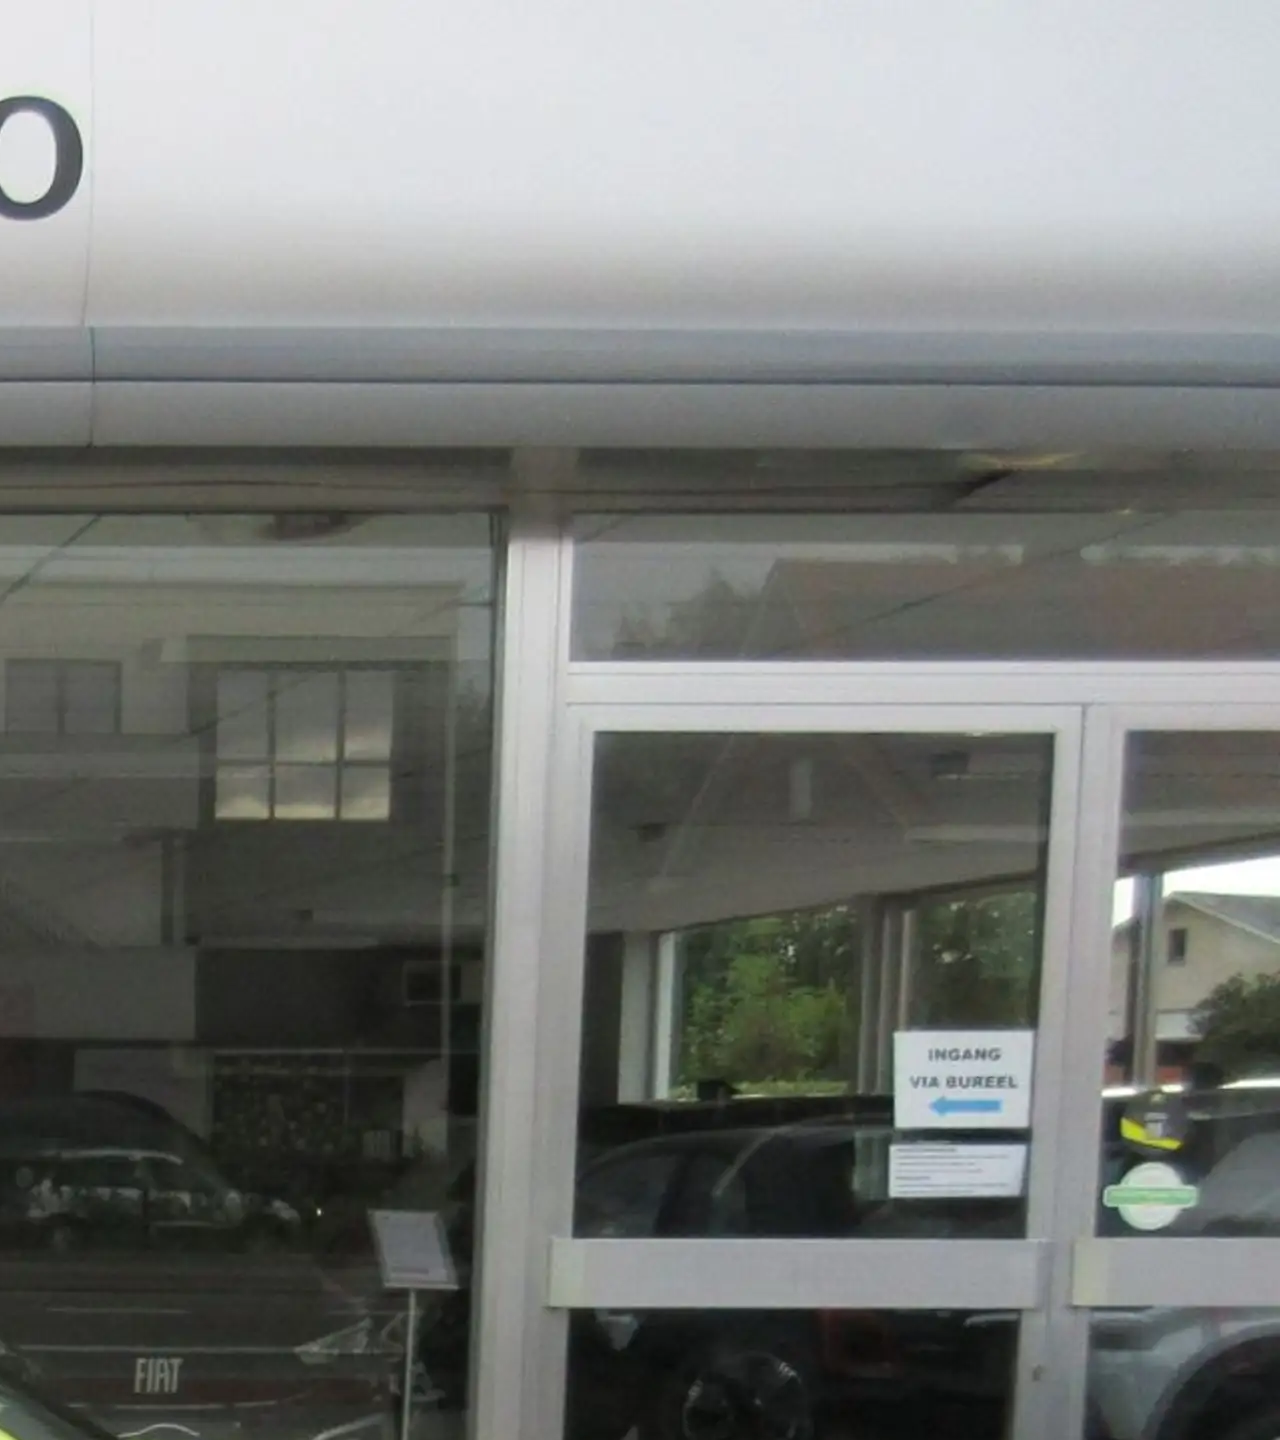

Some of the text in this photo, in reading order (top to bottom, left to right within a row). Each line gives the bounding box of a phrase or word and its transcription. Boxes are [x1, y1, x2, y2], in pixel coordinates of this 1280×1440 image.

[928, 1047, 1002, 1062] INGANG
[910, 1075, 1018, 1089] VIA BUREEL
[134, 1357, 184, 1394] FIAT
